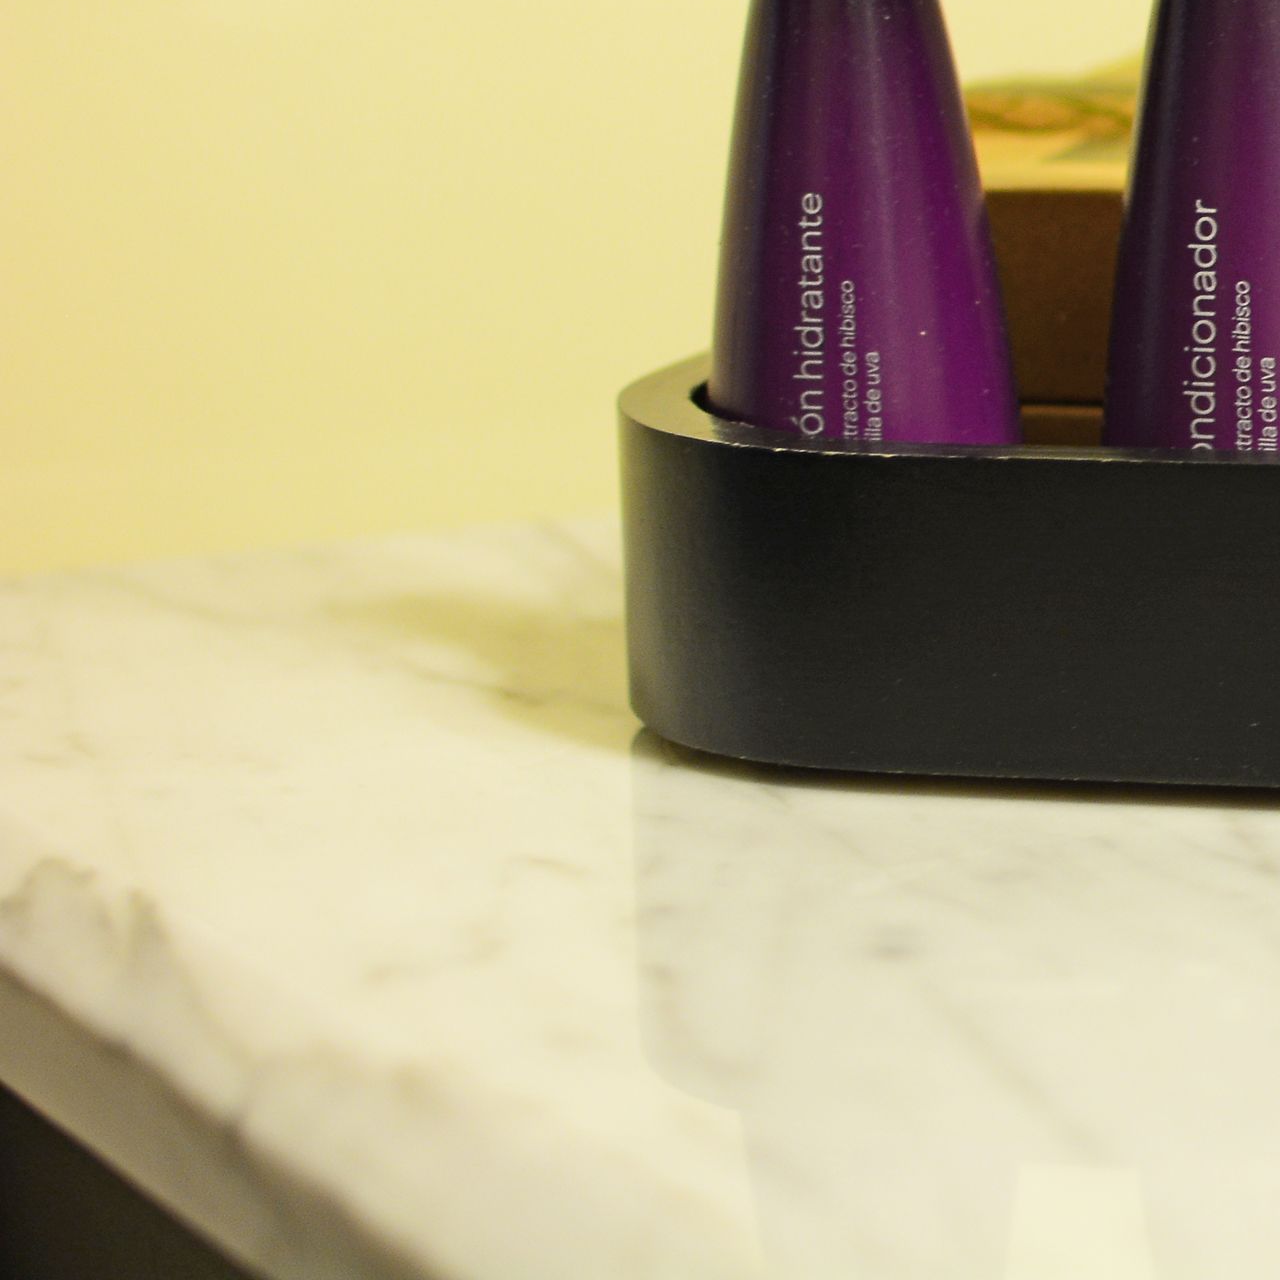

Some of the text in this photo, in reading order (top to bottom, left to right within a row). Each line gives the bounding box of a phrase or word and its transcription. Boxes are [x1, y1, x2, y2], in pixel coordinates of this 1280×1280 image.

[790, 192, 824, 435] ón hidratante
[1231, 281, 1250, 353] hibisco
[838, 280, 858, 440] tracto de hibisco
[865, 351, 881, 385] uva
[1232, 356, 1252, 382] de
[1259, 357, 1276, 392] uva
[863, 389, 881, 413] de
[1258, 396, 1277, 422] de
